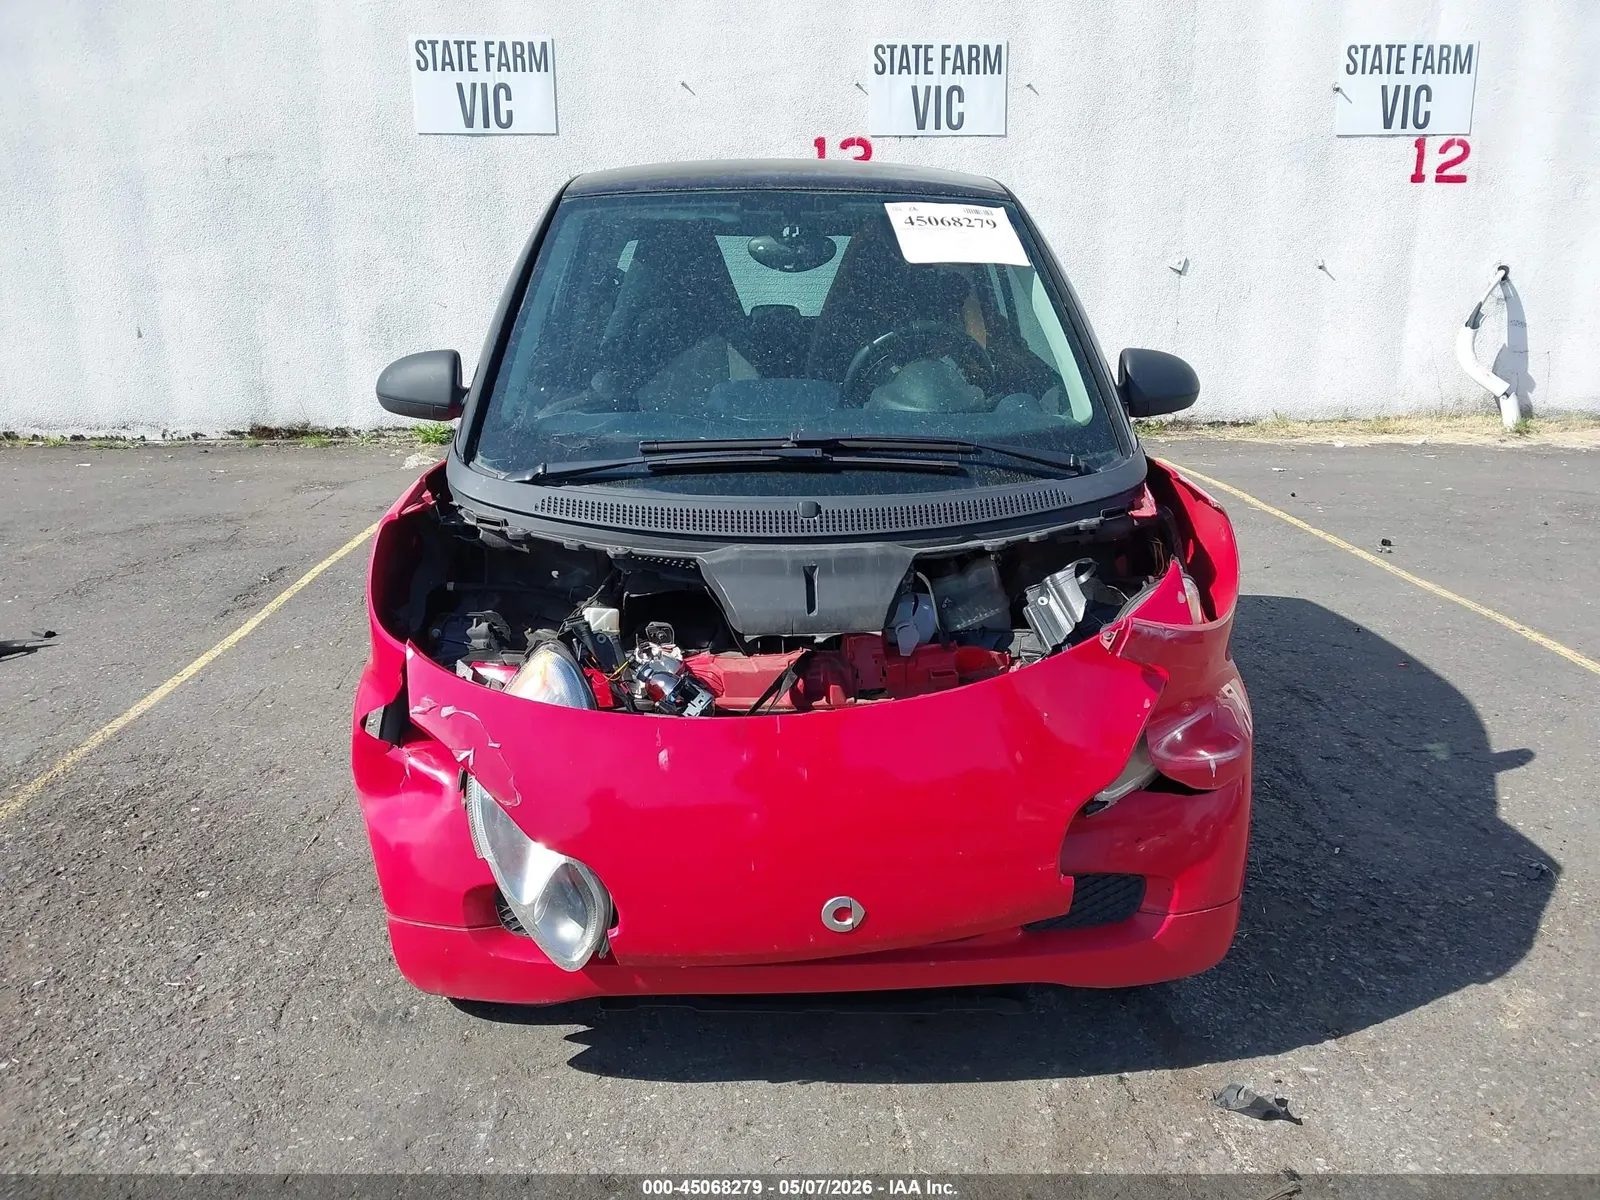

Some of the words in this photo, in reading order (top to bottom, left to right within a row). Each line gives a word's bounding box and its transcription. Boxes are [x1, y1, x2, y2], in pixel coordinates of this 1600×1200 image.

[414, 39, 479, 72] STATE
[484, 40, 549, 73] FARM
[873, 43, 934, 76] STATE
[940, 44, 1003, 76] FARM
[1345, 44, 1407, 76] STATE
[1411, 43, 1474, 75] FARM
[455, 82, 514, 129] VIC
[911, 85, 965, 131] VIC
[1381, 84, 1433, 130] VIC
[1410, 137, 1471, 184] 12
[904, 215, 997, 230] 45068279
